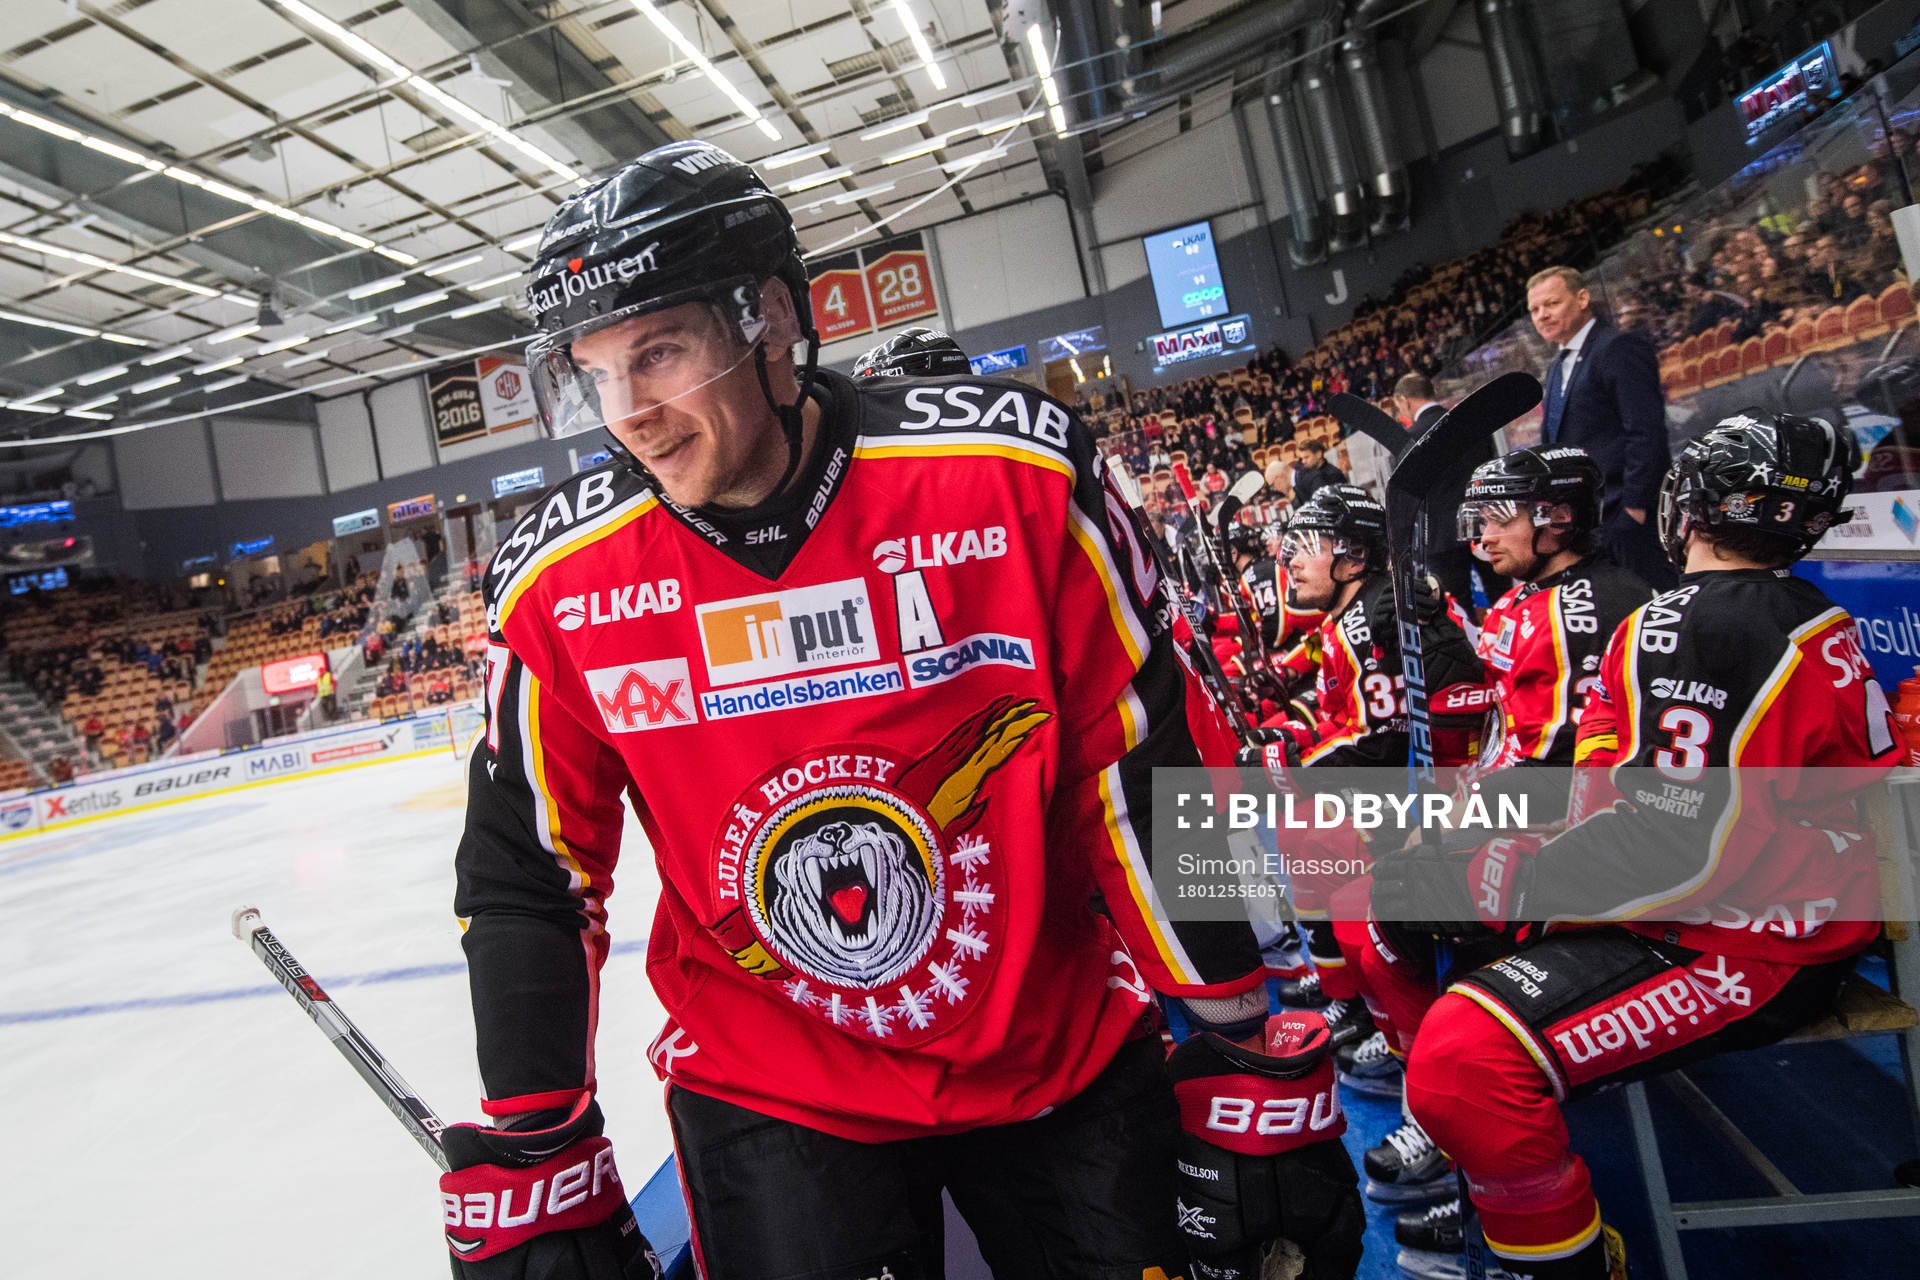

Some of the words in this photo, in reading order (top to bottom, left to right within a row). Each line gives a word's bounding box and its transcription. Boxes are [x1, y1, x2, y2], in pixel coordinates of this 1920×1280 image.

[825, 284, 847, 318] 4
[876, 262, 922, 306] 28
[1325, 269, 1348, 306] J
[1156, 329, 1221, 358] MAXI
[437, 401, 481, 431] 2016
[899, 386, 1070, 449] SSAB
[804, 446, 848, 530] BAUER
[1774, 501, 1796, 523] 3
[492, 470, 615, 599] SSAB
[744, 524, 788, 546] SHL
[910, 525, 1008, 568] LKAB
[590, 578, 682, 626] LKAB
[893, 568, 946, 655] A
[1255, 585, 1276, 613] 14
[811, 645, 865, 662] interiör
[912, 638, 1032, 682] SCANIA
[594, 667, 692, 730] MAX
[703, 670, 902, 719] Handelsbanken
[1671, 680, 1729, 711] LKAB
[250, 751, 301, 775] MABI
[1654, 705, 1714, 783] 3
[134, 765, 231, 798] BAUER
[1661, 783, 1705, 806] TEAM
[45, 789, 122, 820] Xentus
[1635, 789, 1699, 820] SPORTIA
[718, 801, 763, 901] LULEÅ
[760, 754, 895, 807] HOCKEY
[258, 927, 309, 979] NEXUS
[1504, 954, 1549, 984] Luleå
[263, 952, 320, 1024] BAUER
[1491, 961, 1545, 999] Energi
[440, 1145, 619, 1229] BAUER
